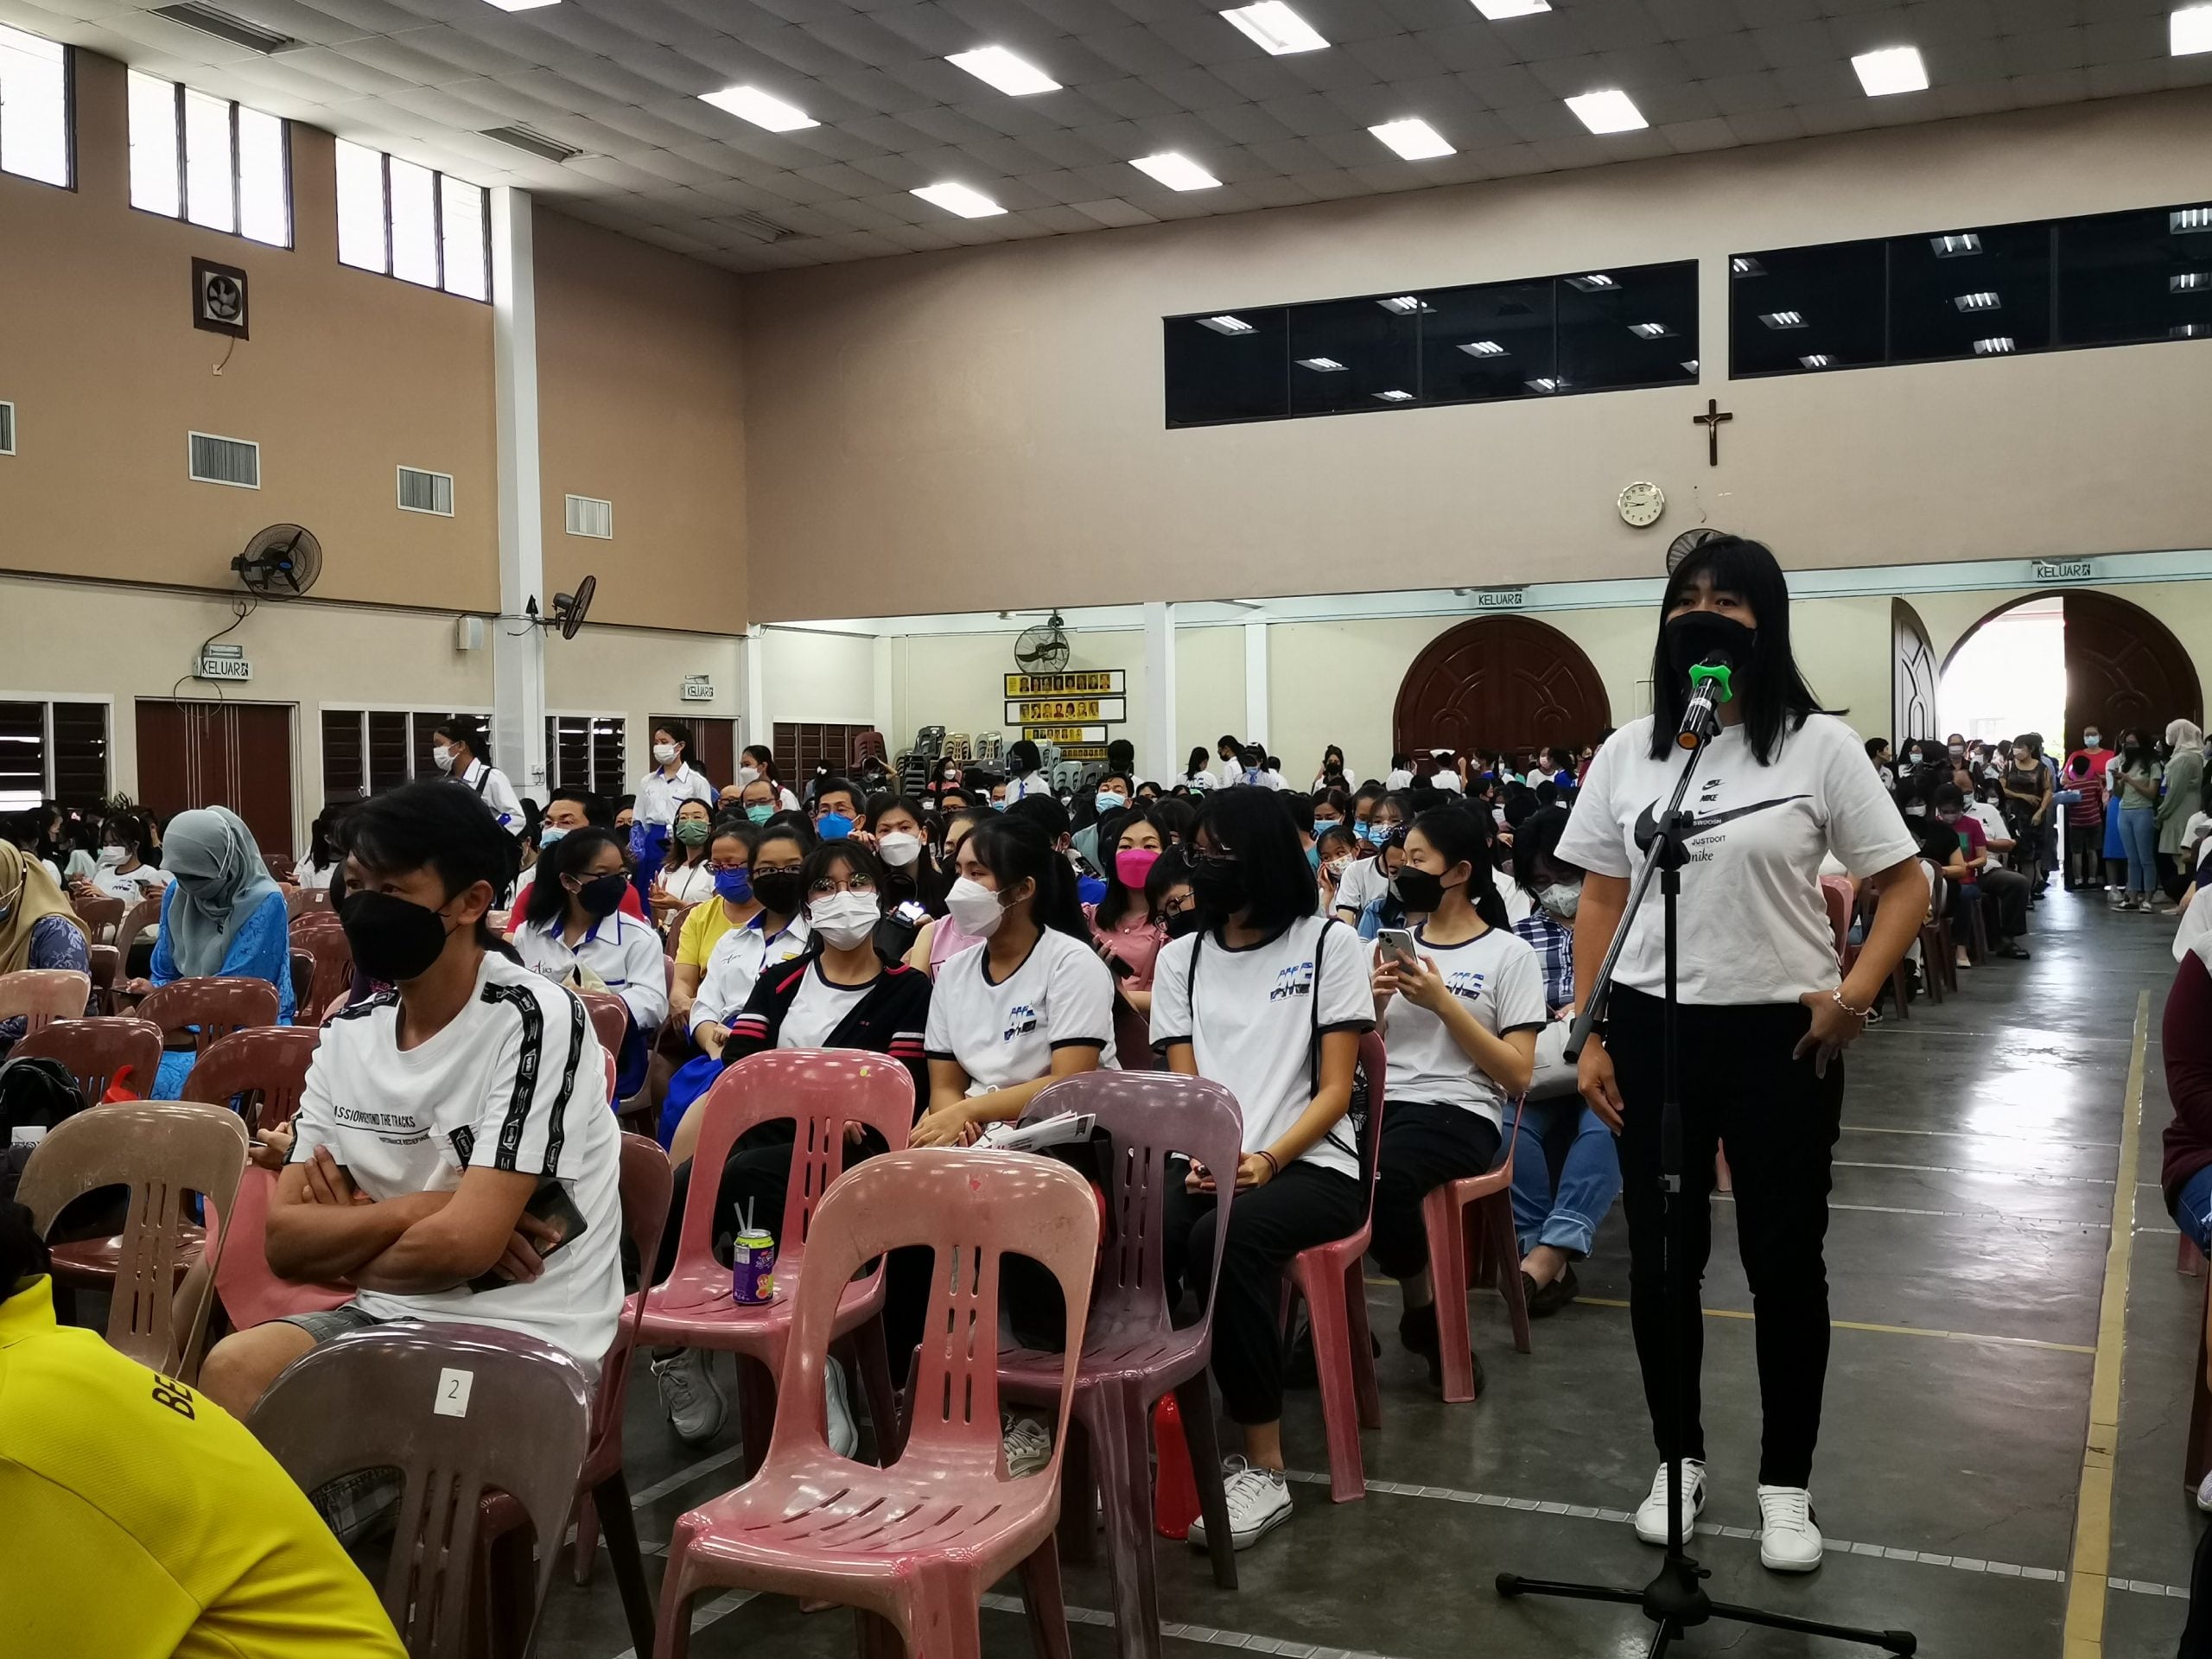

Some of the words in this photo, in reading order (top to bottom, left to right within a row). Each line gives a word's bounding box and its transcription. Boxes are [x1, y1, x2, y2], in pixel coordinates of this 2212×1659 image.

[2037, 564, 2082, 578] KELUAR
[1478, 594, 1514, 606] KELUAR
[202, 660, 241, 676] KELUAR
[1691, 848, 1714, 862] nike
[448, 1378, 460, 1400] 2
[151, 1373, 196, 1421] BE
